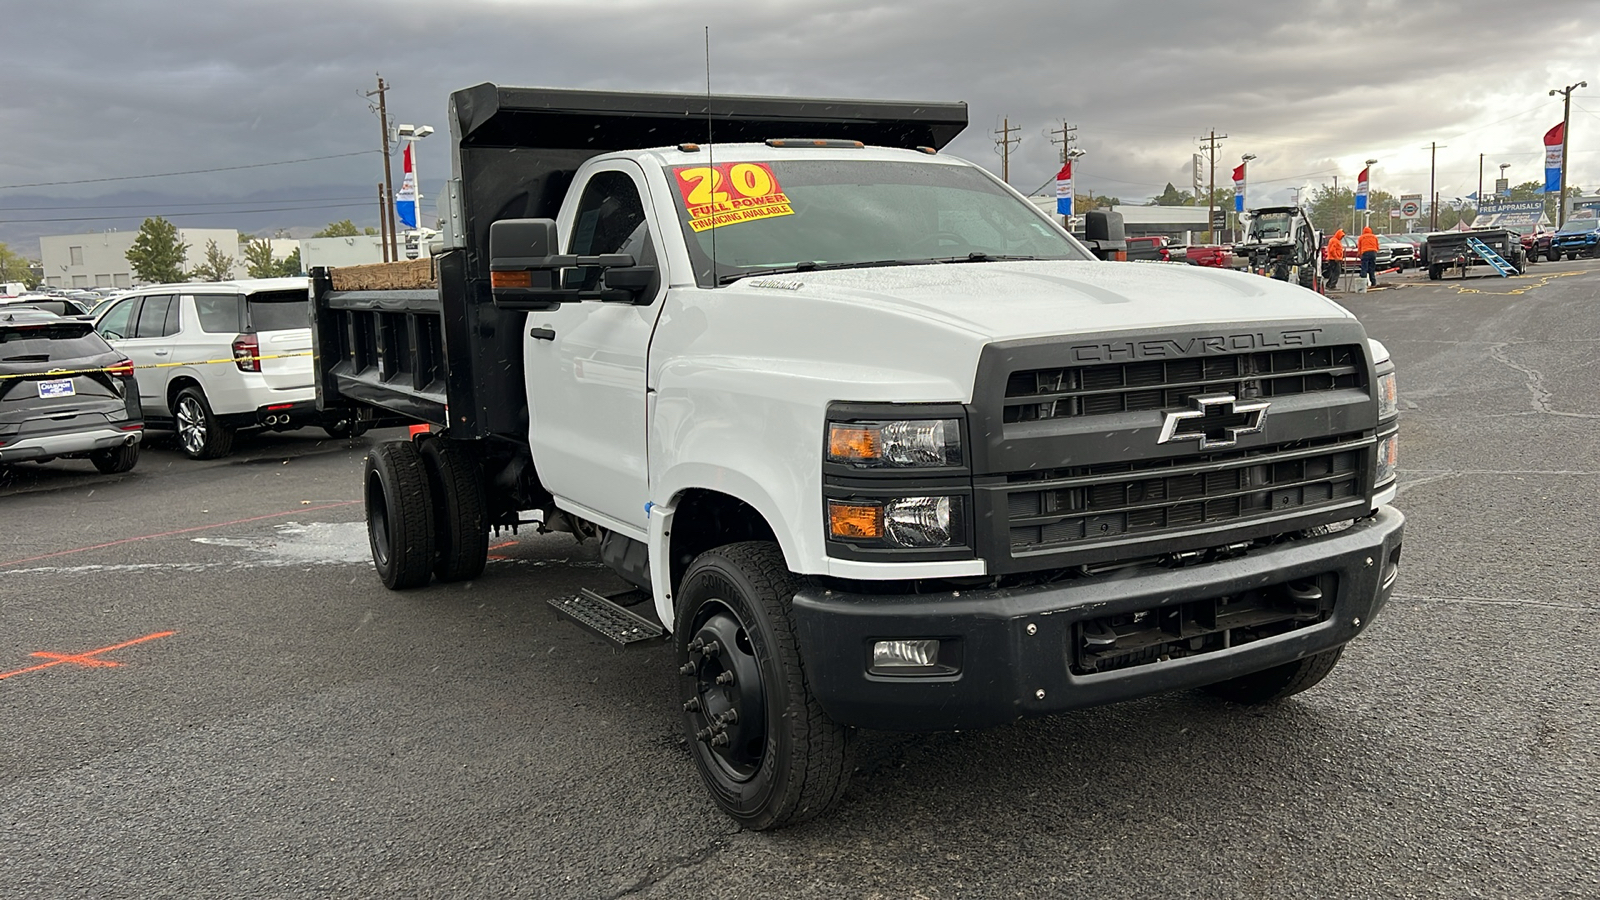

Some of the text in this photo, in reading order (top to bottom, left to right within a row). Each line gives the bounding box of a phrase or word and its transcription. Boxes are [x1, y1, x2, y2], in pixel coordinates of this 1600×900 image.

[680, 164, 775, 205] 20
[691, 195, 787, 218] FULL POWER
[692, 205, 790, 230] FINANCING AVAILABLE
[1497, 203, 1541, 212] APPRAISALS!
[1070, 328, 1322, 363] CHEVROLET
